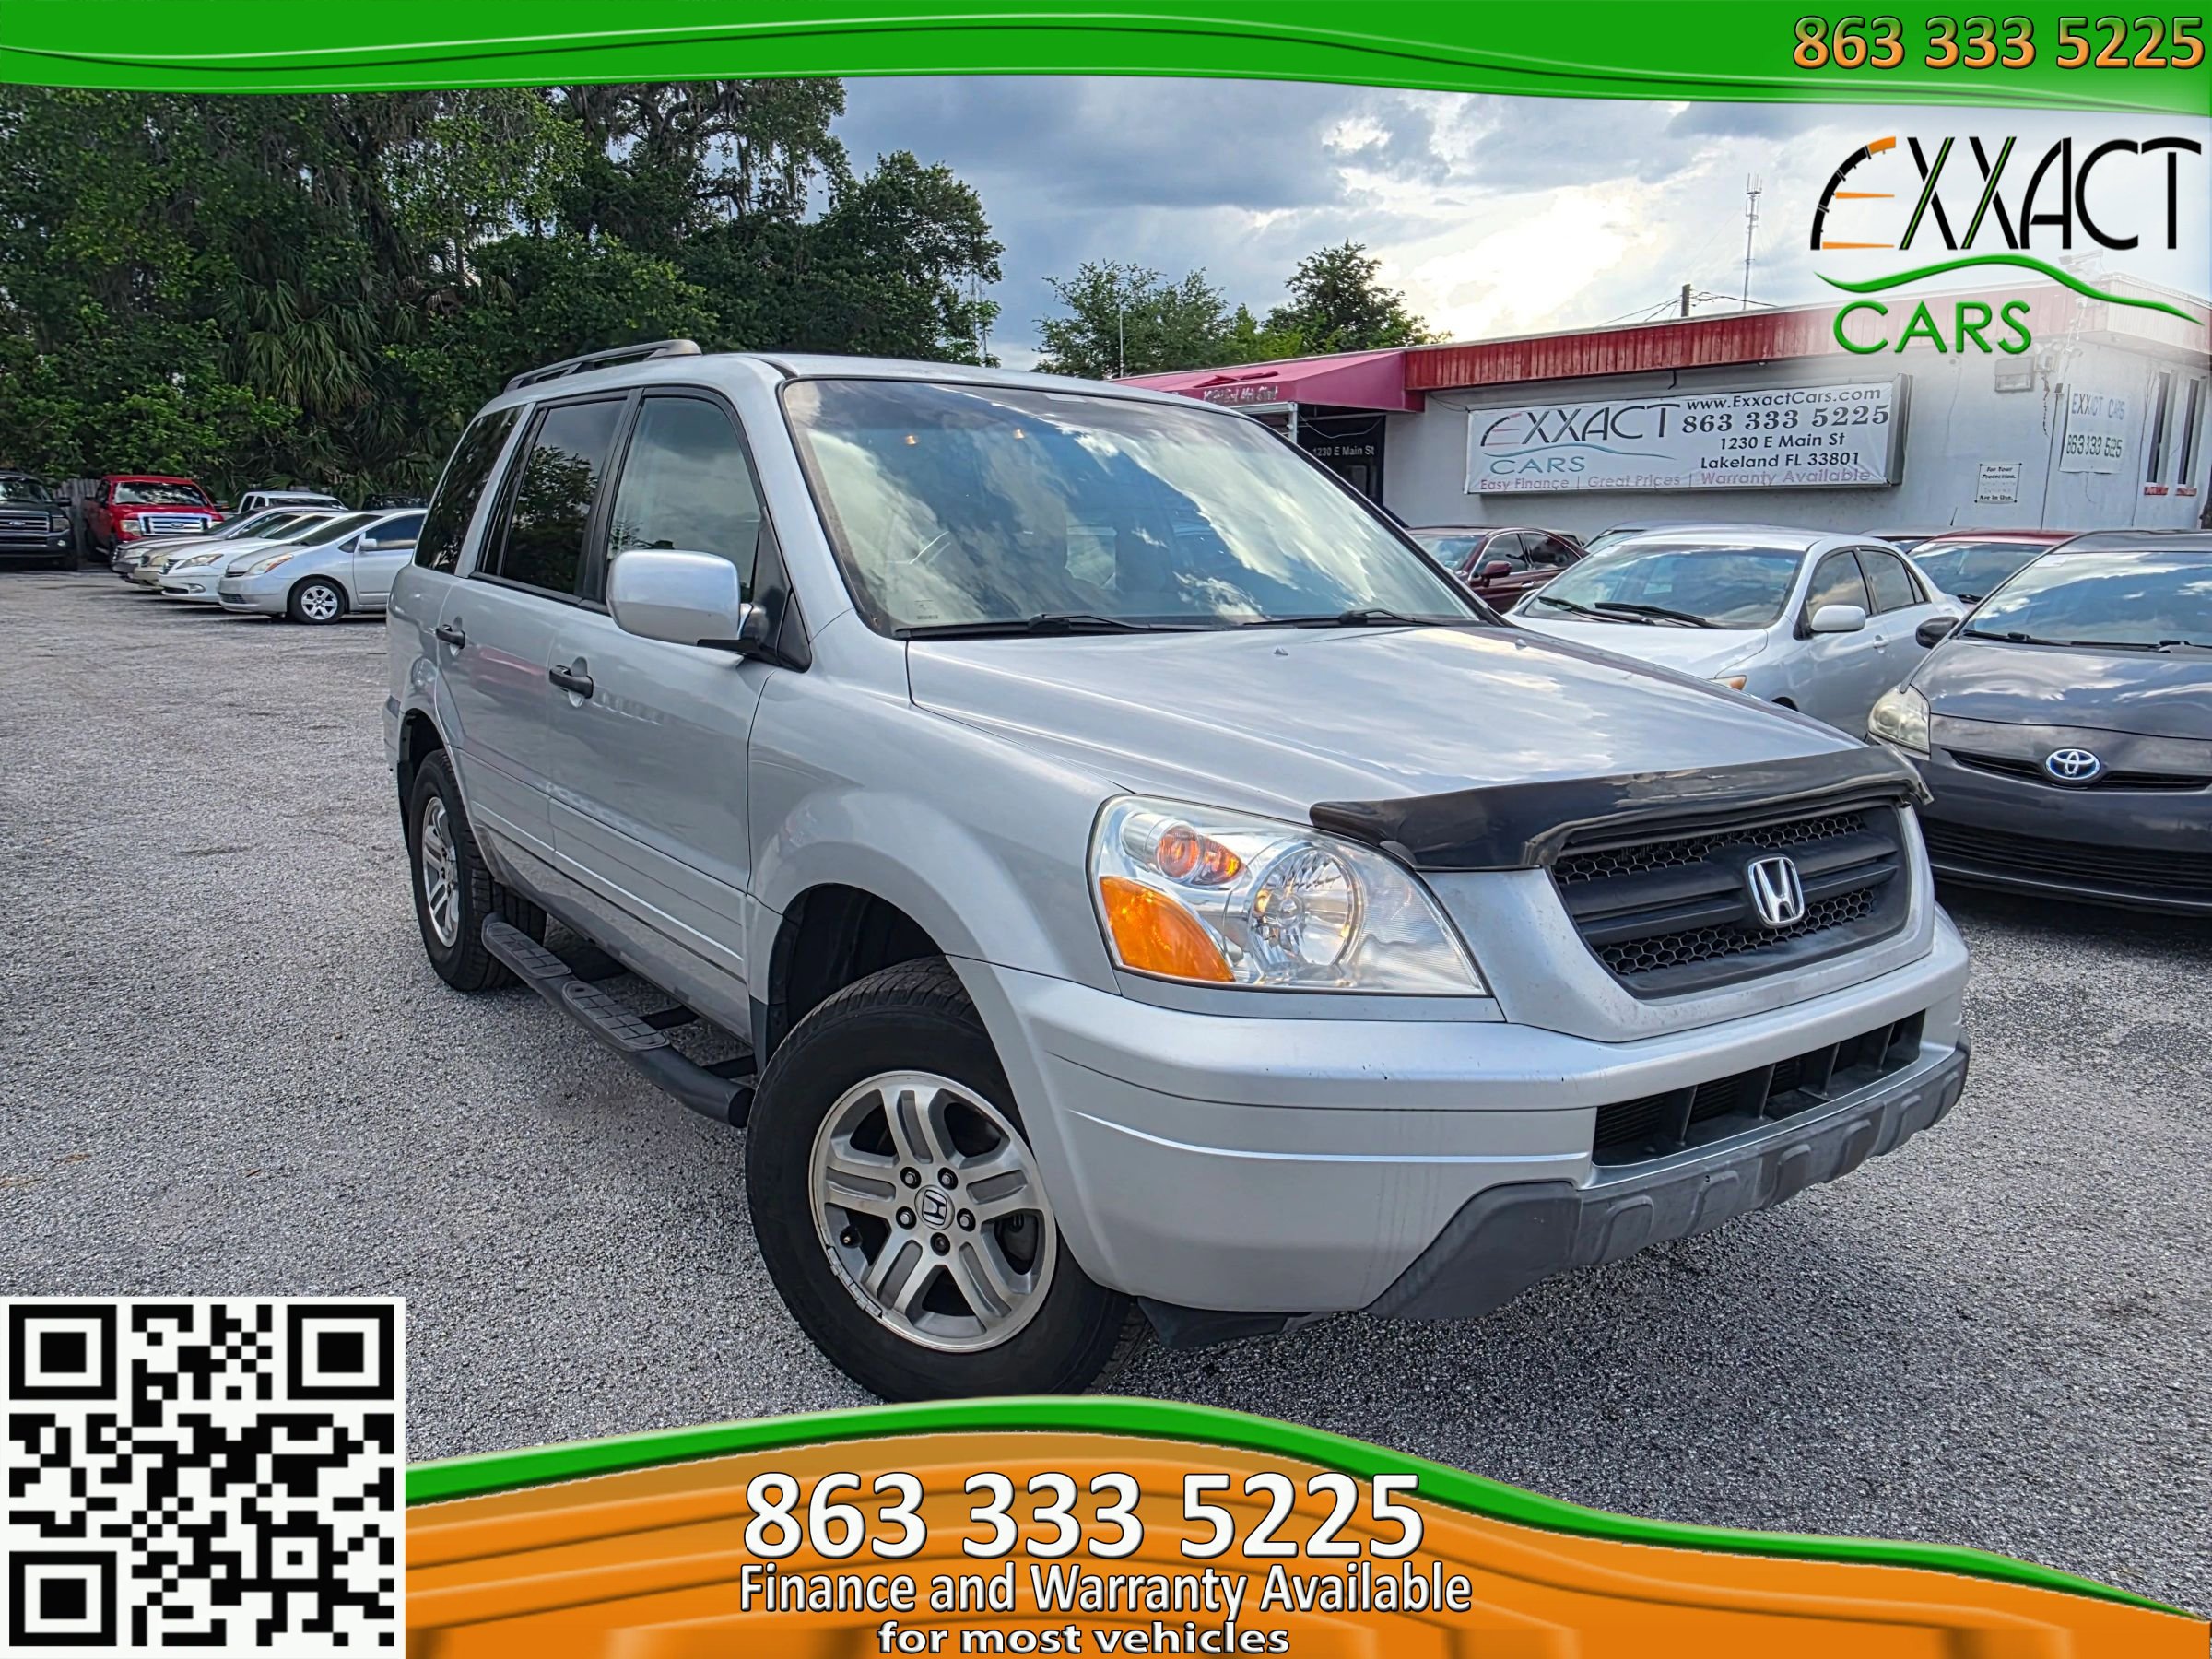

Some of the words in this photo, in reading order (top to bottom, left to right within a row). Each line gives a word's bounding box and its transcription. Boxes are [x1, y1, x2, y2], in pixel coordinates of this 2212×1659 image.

[1687, 389, 1881, 410] www.ExxactCars.com
[1480, 404, 1680, 446] EXXACT
[1682, 413, 1733, 433] 863
[1745, 409, 1799, 430] 333
[1811, 404, 1890, 427] 5225
[1312, 447, 1333, 457] 1230
[1334, 446, 1340, 455] E
[1342, 445, 1363, 455] Main
[1720, 437, 1759, 450] 1230
[1763, 436, 1772, 448] E
[1778, 433, 1822, 448] Main
[1829, 432, 1845, 445] St
[1489, 456, 1585, 475] CARS
[1700, 454, 1779, 469] Lakeland
[1785, 454, 1802, 466] FL
[1807, 452, 1859, 465] 33801
[1480, 478, 1509, 491] Easy
[1513, 477, 1569, 489] Finance
[1587, 474, 1630, 488] Great
[1635, 474, 1680, 487] Prices
[1701, 471, 1777, 486] Warranty
[1783, 468, 1871, 483] Available
